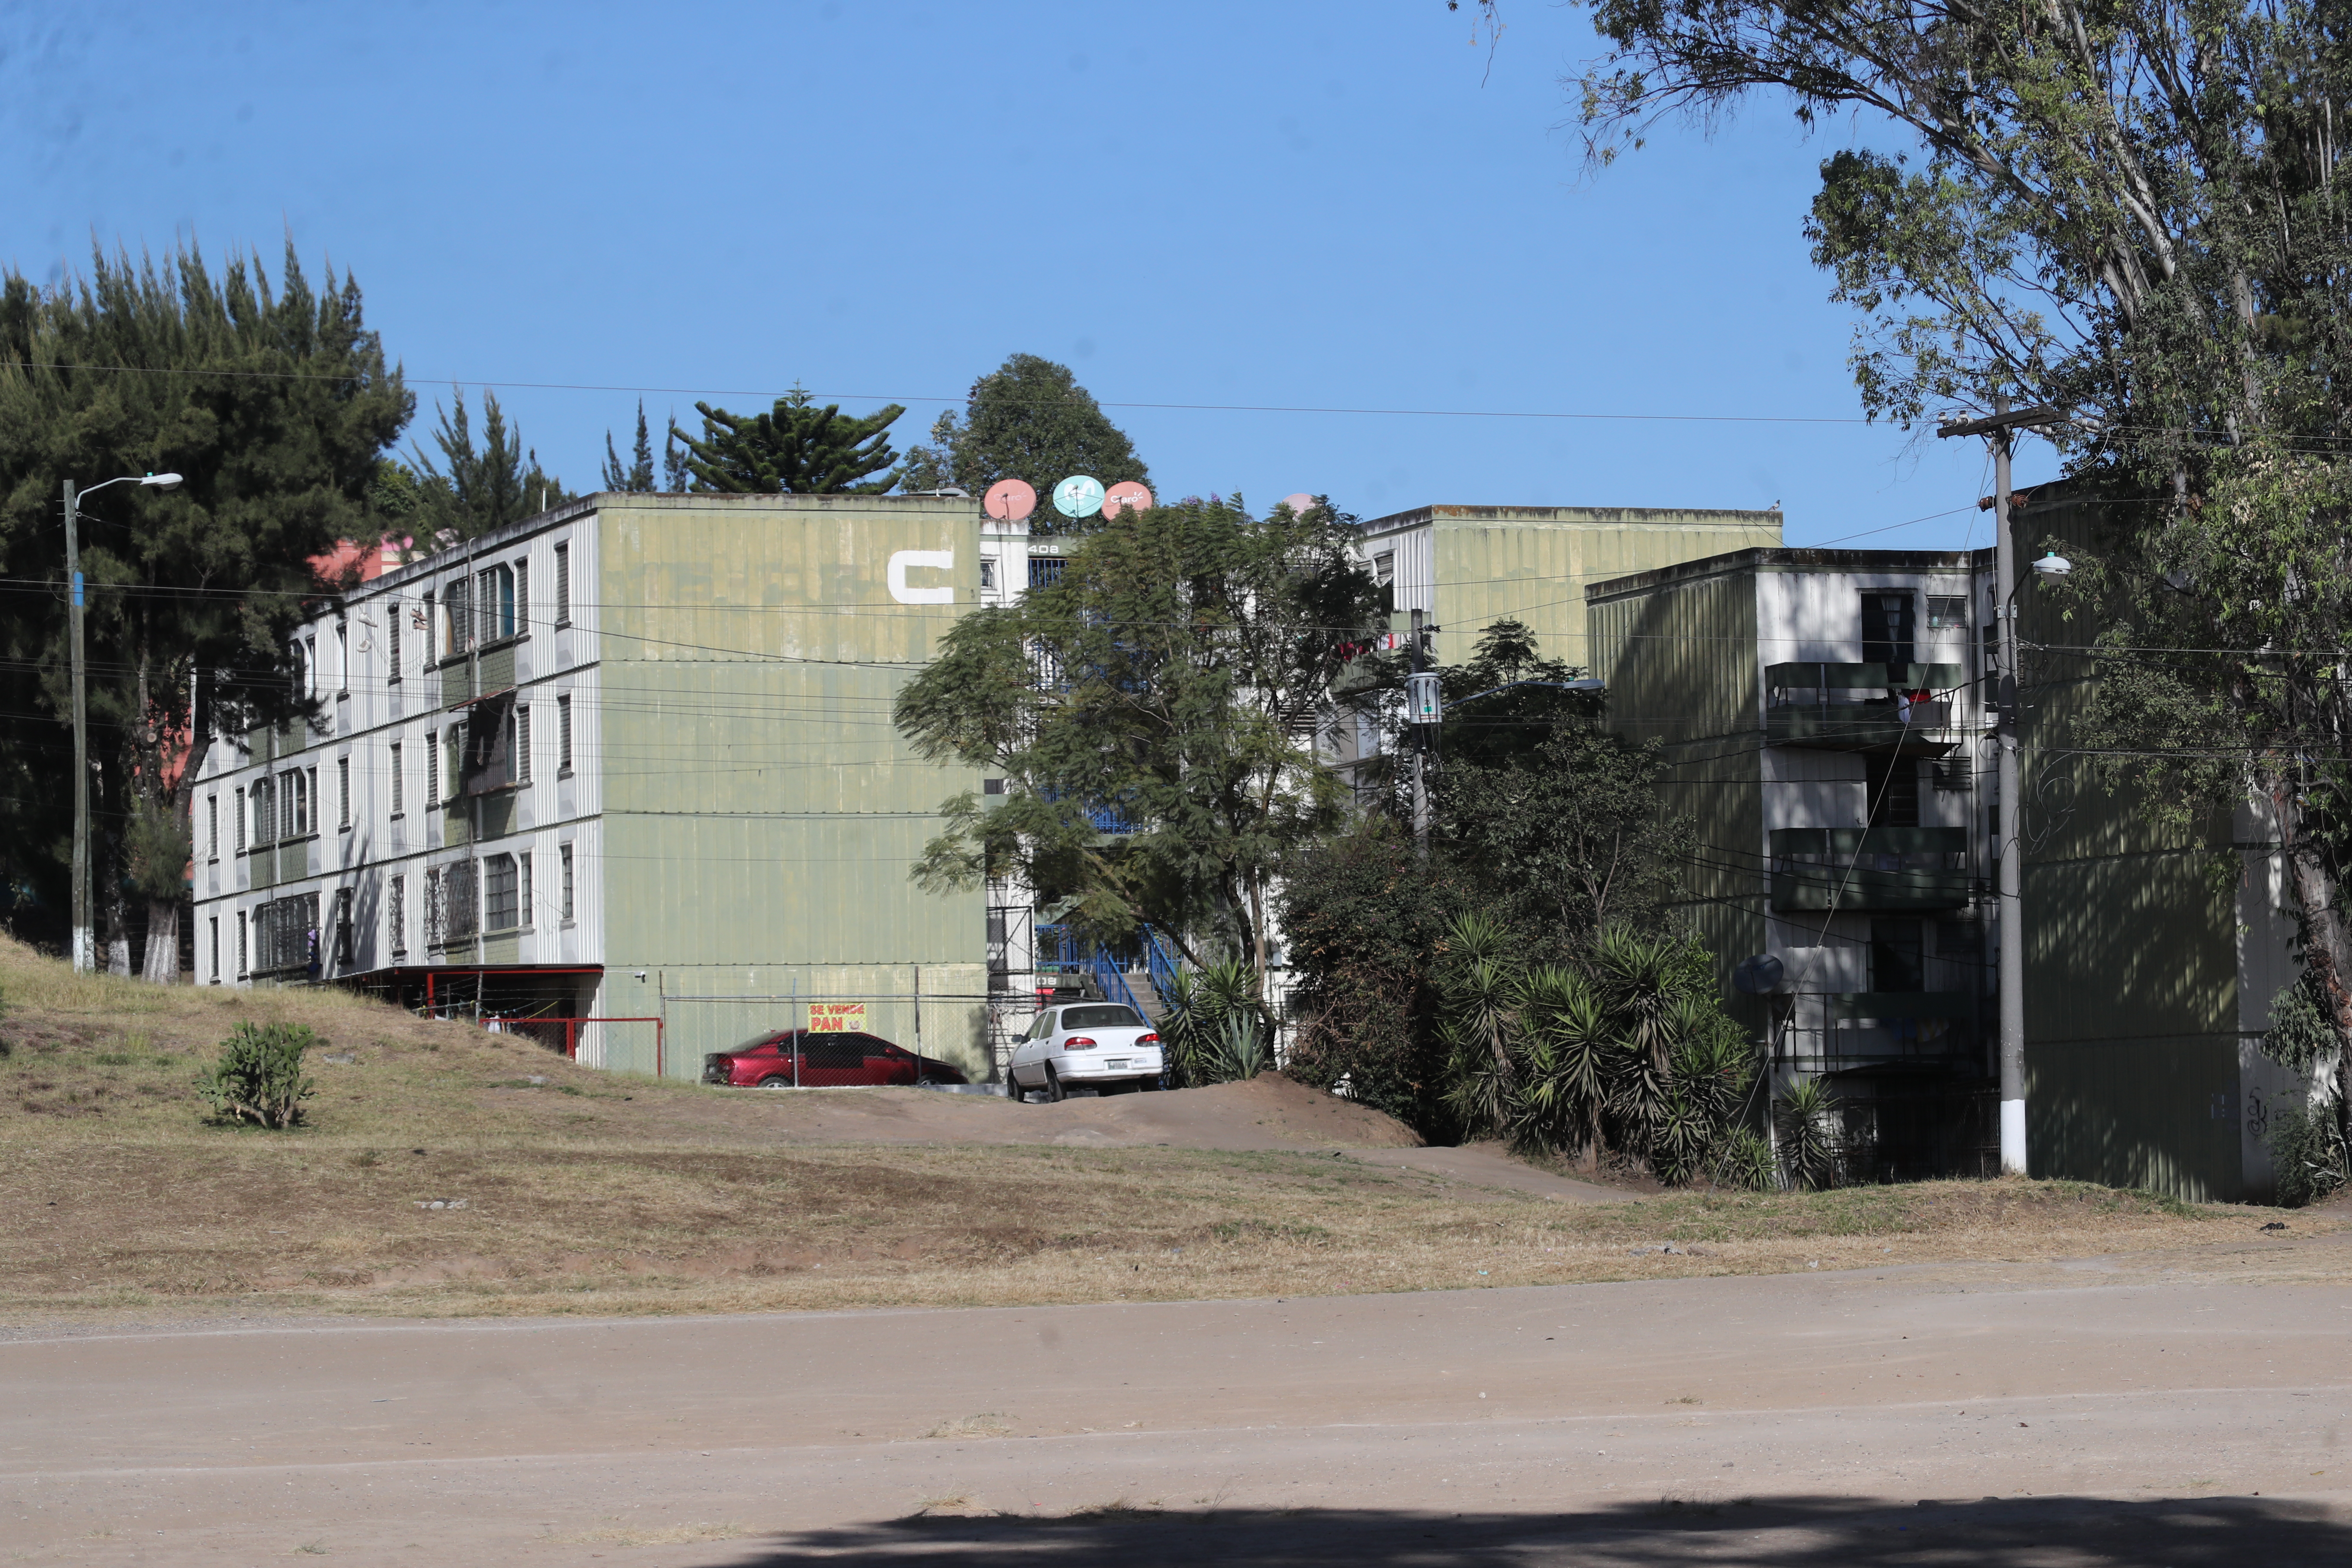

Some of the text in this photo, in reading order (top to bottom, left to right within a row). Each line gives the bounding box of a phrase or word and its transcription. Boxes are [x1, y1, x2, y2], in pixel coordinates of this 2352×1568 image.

[993, 493, 1023, 501] Caro
[1110, 495, 1139, 503] Caro
[1028, 545, 1059, 554] 408
[888, 550, 954, 604] C
[810, 1004, 864, 1015] SE VENDE
[811, 1017, 842, 1031] PAN
